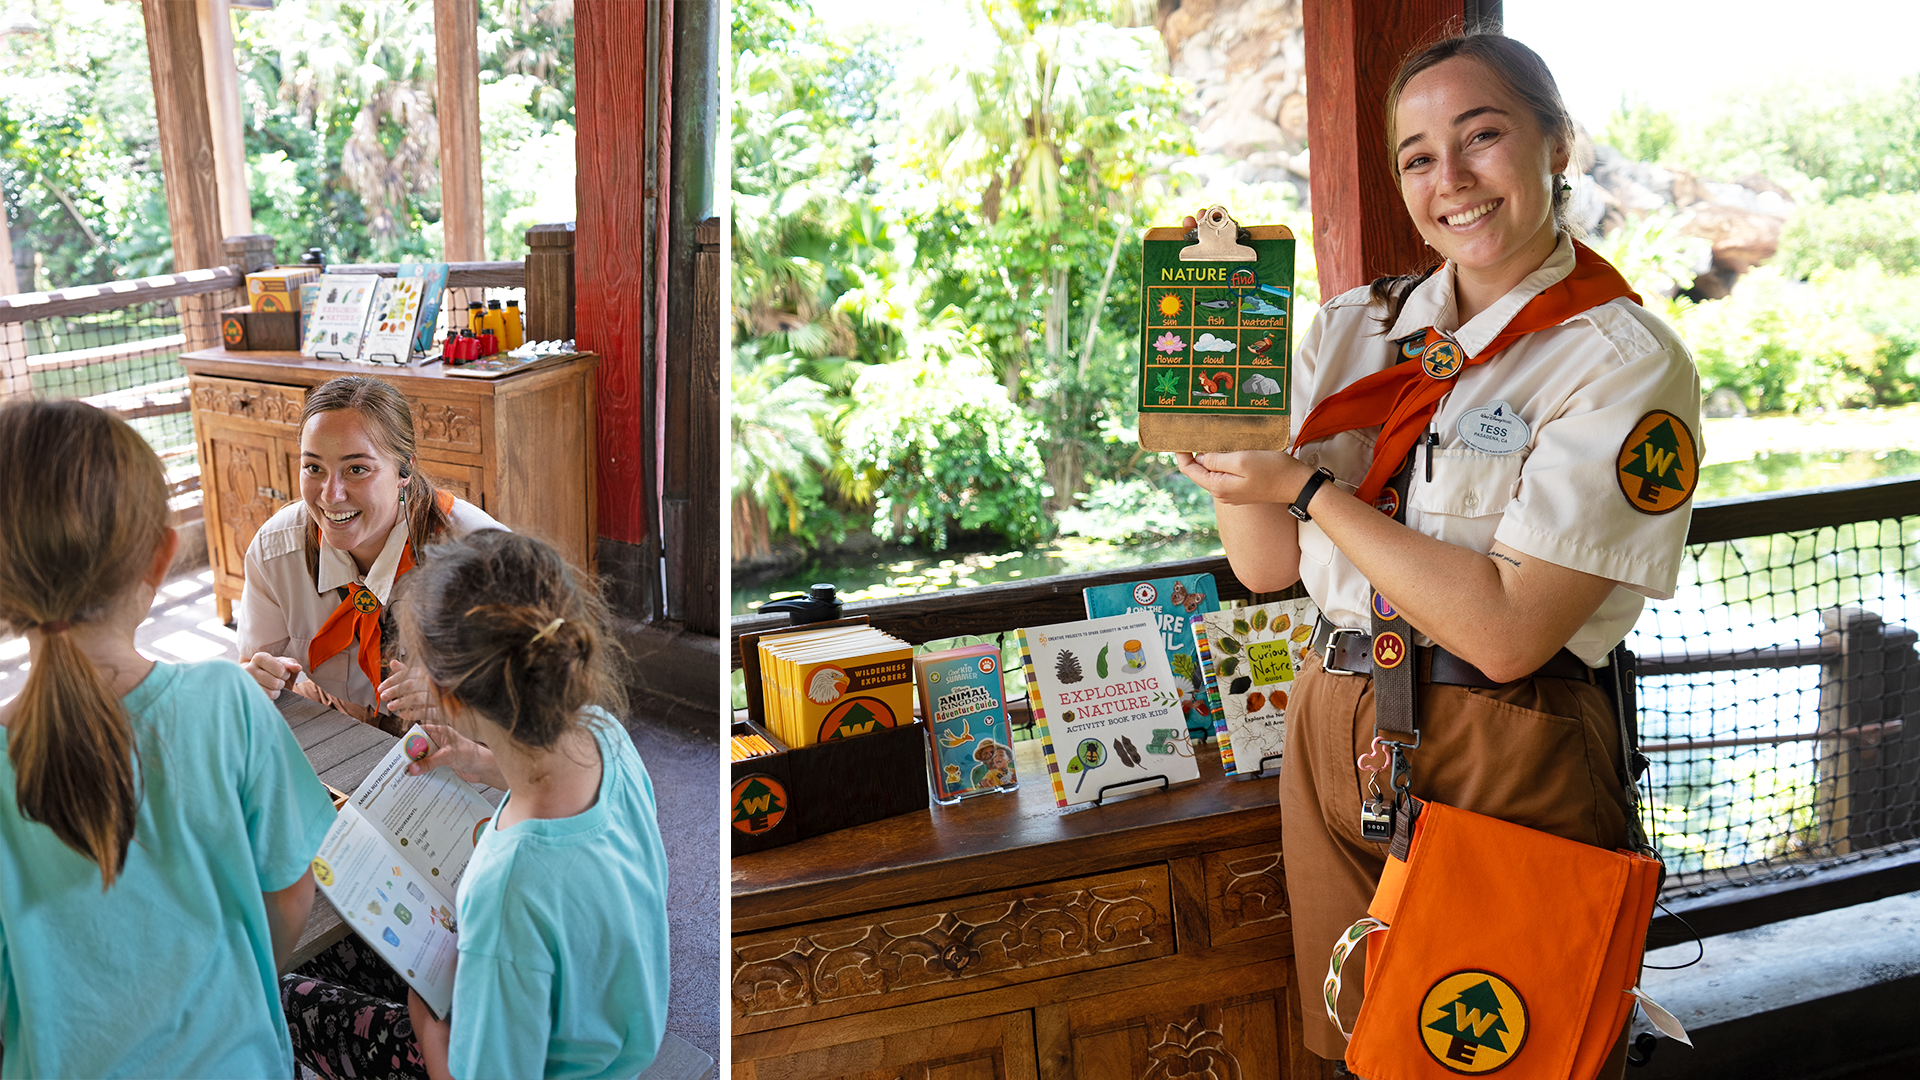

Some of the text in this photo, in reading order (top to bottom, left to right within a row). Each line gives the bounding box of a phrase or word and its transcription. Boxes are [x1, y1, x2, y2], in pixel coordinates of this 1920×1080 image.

[1161, 267, 1255, 287] NATURE find
[1162, 318, 1178, 326] sun
[1207, 316, 1225, 326] fish
[1242, 316, 1284, 326] waterfall
[1156, 355, 1184, 365] flower
[1202, 354, 1224, 364] cloud
[1252, 356, 1272, 366] duck
[1158, 396, 1176, 406] leaf
[1198, 396, 1228, 406] animal
[1250, 397, 1270, 406] rock
[1474, 432, 1499, 442] PASADENA,
[1480, 423, 1508, 437] TESS
[1248, 646, 1288, 662] Curious
[855, 663, 906, 677] WILDERNESS
[1253, 660, 1290, 680] Nature
[861, 672, 906, 686] EXPLORERS
[946, 673, 978, 684] SUMMER
[940, 688, 986, 705] ANIMAL
[1059, 677, 1159, 705] EXPLORING
[936, 700, 997, 721] Adventure Guide
[941, 696, 987, 711] KINGDOM
[1077, 696, 1150, 719] NATURE
[1066, 708, 1168, 733] ACTIVITY BOOK FOR KIDS
[358, 789, 373, 806] ANIMAL
[389, 753, 402, 769] BADGE
